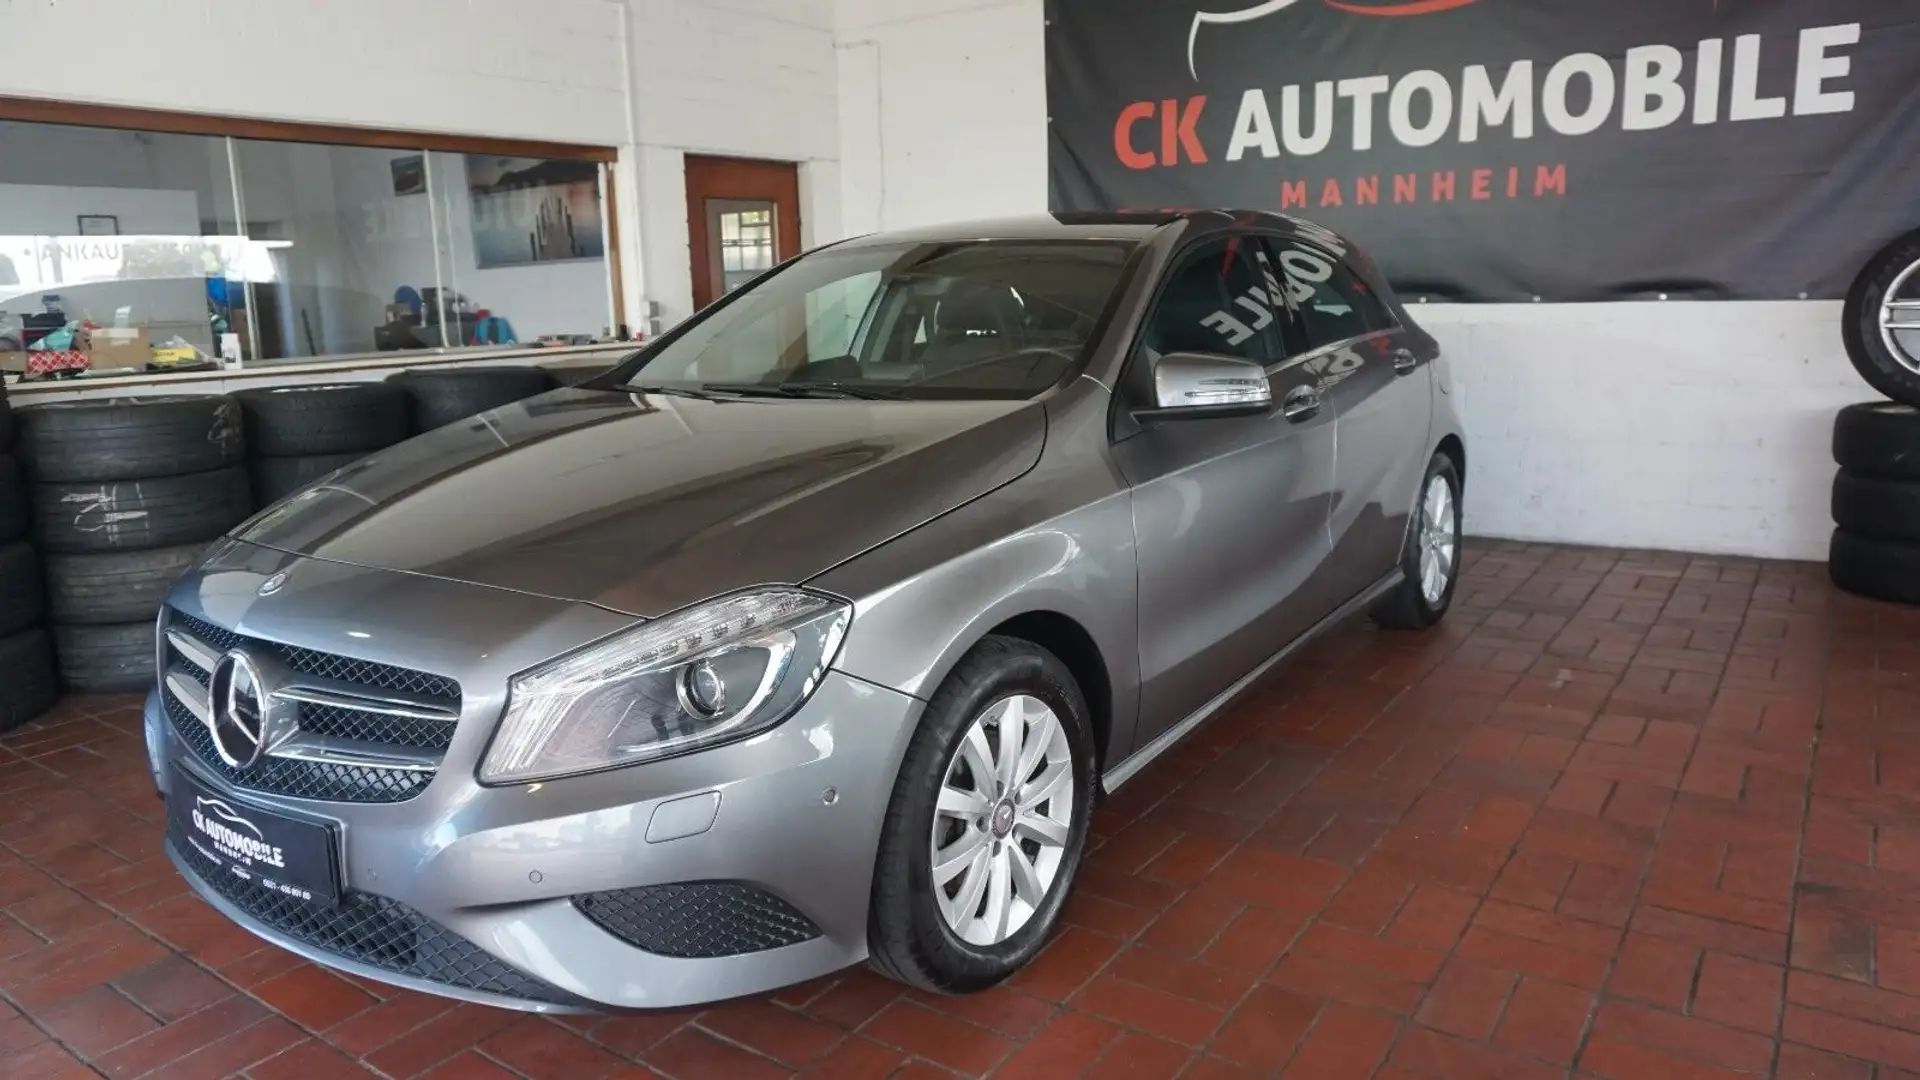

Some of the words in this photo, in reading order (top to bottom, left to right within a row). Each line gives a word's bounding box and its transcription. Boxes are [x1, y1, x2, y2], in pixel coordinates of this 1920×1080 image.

[1114, 95, 1209, 169] CK
[1225, 23, 1861, 162] AUTOMOBILE
[1281, 164, 1567, 208] MANNHEIM
[205, 818, 285, 867] AUTOMOBILE
